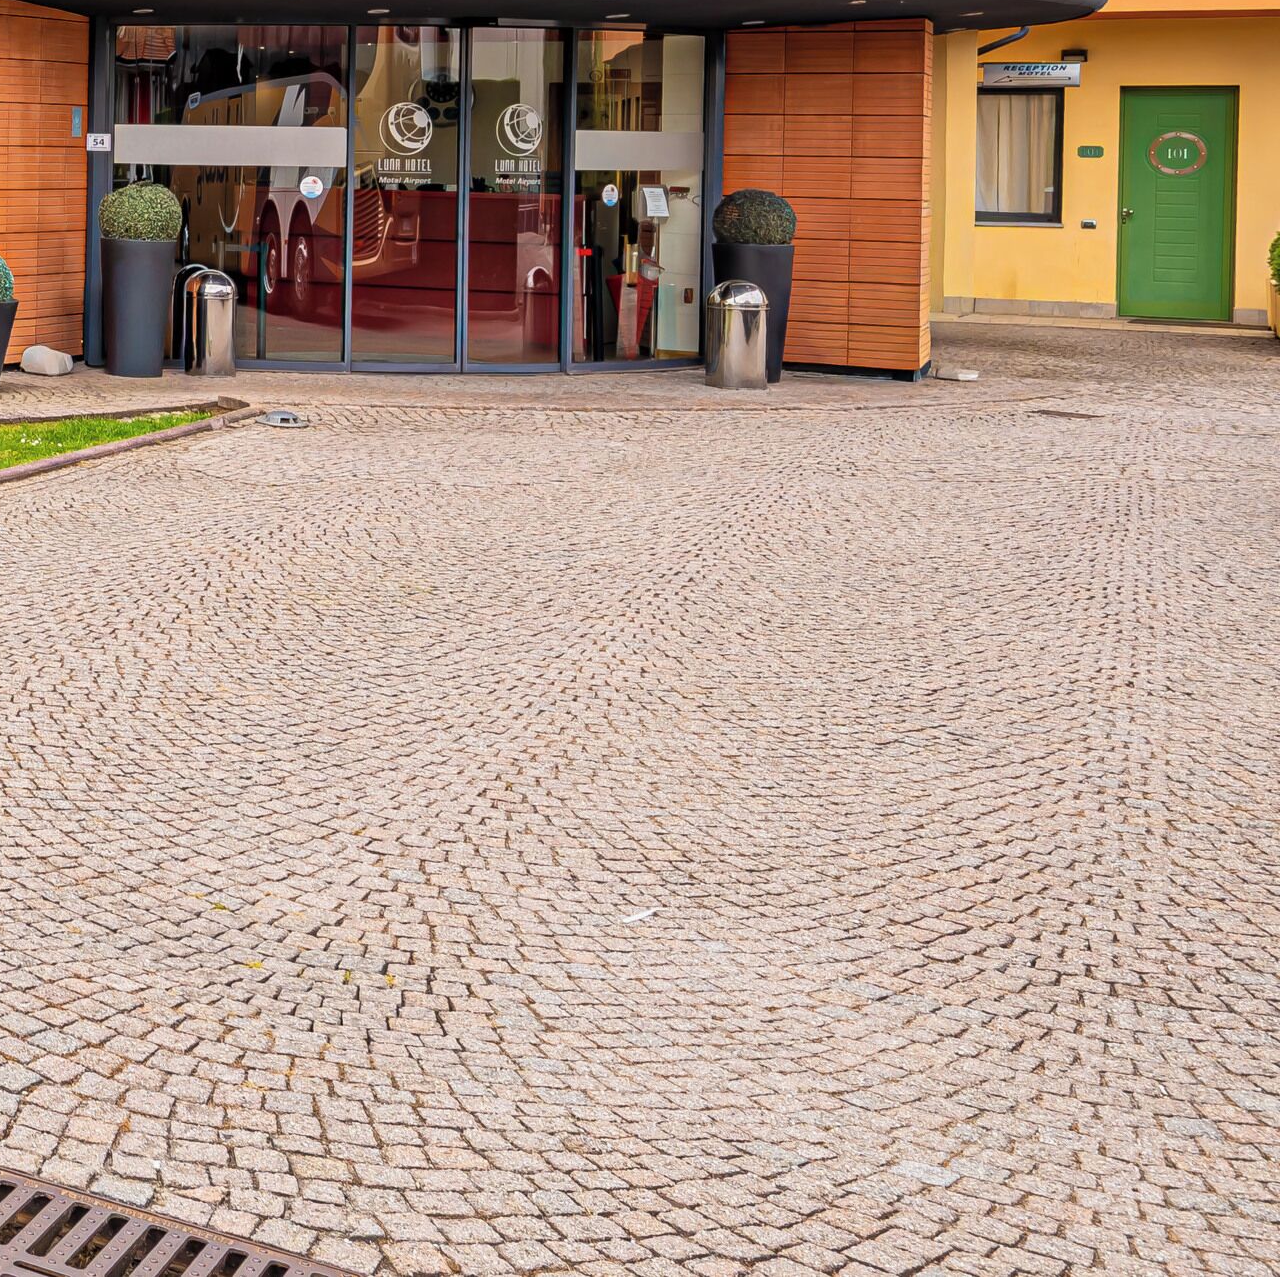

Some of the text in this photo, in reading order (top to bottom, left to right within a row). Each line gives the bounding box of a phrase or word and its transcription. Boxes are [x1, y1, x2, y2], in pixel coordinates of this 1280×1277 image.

[92, 138, 105, 146] 54
[1167, 148, 1188, 159] 101
[377, 158, 433, 172] LUNA HOTEL
[494, 159, 541, 172] LUNA HOTEL
[378, 176, 432, 186] Motel Airport
[495, 177, 541, 187] Motel Airport
